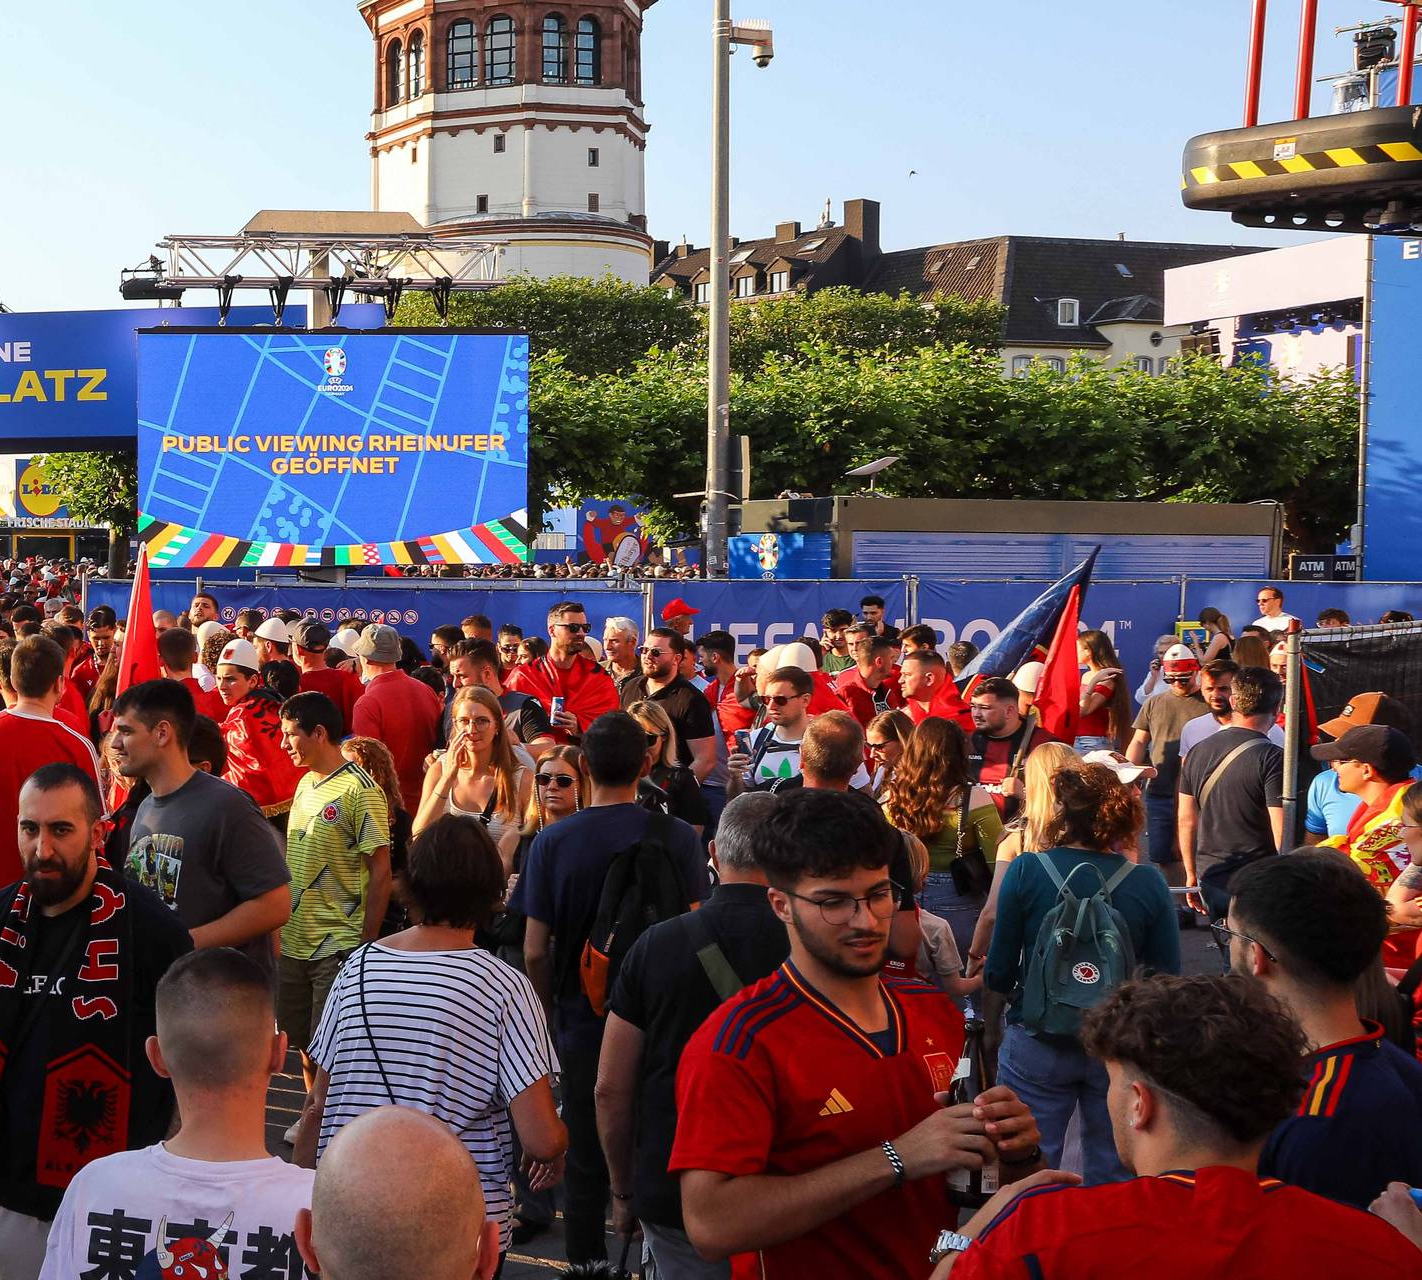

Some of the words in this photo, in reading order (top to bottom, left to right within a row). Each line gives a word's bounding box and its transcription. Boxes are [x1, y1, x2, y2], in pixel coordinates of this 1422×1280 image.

[162, 435, 250, 453] PUBLIC
[254, 434, 364, 453] VIEWING
[369, 434, 506, 452] RHEINUFER
[271, 453, 400, 475] GEÖFFNET
[1299, 561, 1325, 571] ATM
[1334, 561, 1355, 571] ATM
